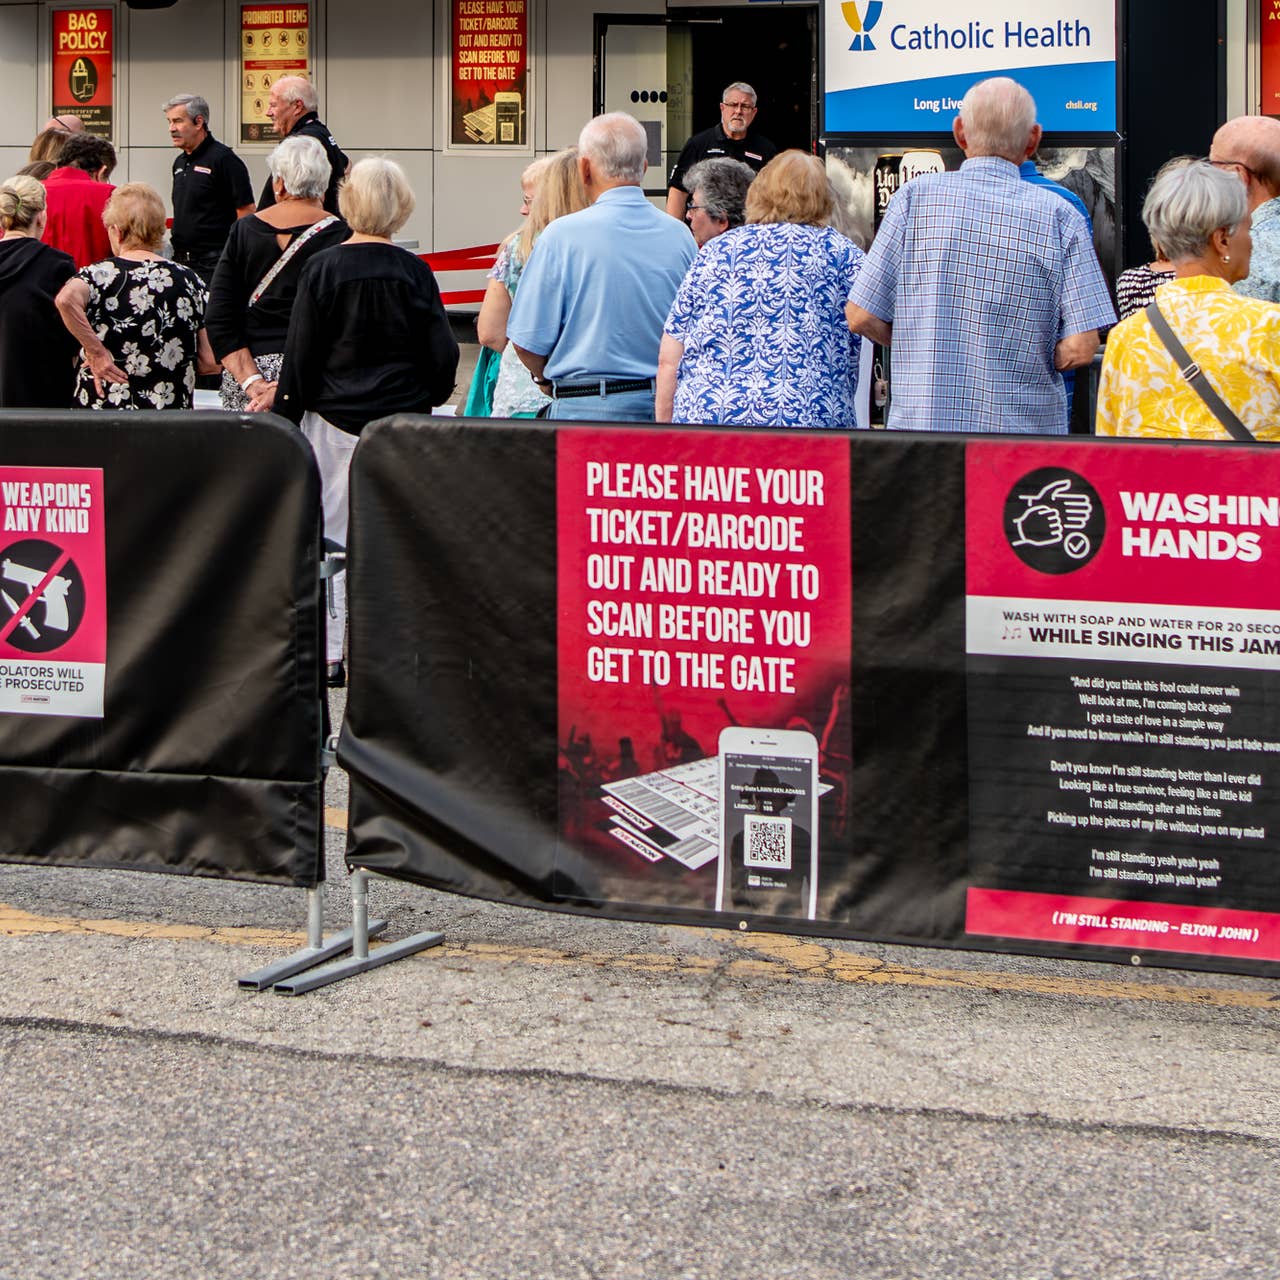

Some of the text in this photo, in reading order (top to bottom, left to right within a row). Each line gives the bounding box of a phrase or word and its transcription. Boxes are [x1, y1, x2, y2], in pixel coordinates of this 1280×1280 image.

[459, 0, 524, 14] PLEASE HAVE YOUR
[1269, 12, 1276, 20] A
[68, 13, 97, 30] BAG
[242, 9, 307, 24] PROHIBITED ITEMS
[459, 17, 518, 31] TICKET/BARCODE
[59, 32, 107, 49] POLICY
[459, 33, 522, 47] OUT AND READY TO
[890, 20, 1091, 50] Catholic Health
[459, 50, 520, 63] SCAN BEFORE YOU
[459, 66, 516, 80] GET TO THE GATE
[913, 98, 940, 112] Long
[1065, 100, 1098, 112] chsli.org
[587, 462, 824, 506] PLEASE HAVE YOUR
[2, 482, 91, 508] WEAPONS
[4, 508, 41, 532] ANY
[46, 508, 89, 534] KIND
[586, 508, 804, 552] TICKET/BARCODE
[1122, 528, 1261, 562] HANDS
[587, 554, 820, 600] OUT AND READY TO
[587, 600, 811, 648] SCAN BEFORE YOU
[1003, 611, 1039, 623] WASH
[1044, 613, 1076, 625] WITH
[1080, 615, 1114, 627] SOAP
[1118, 616, 1145, 627] AND
[1149, 618, 1193, 630] WATER
[1197, 620, 1223, 632] FOR
[1227, 621, 1243, 633] 20
[1029, 627, 1092, 646] WHILE
[1097, 630, 1182, 650] SINGING
[1187, 635, 1234, 653] THIS
[57, 667, 84, 680] WILL
[587, 646, 796, 694] GET TO THE GATE
[5, 678, 85, 692] PROSECUTED
[1092, 677, 1104, 689] did
[1104, 681, 1120, 691] you
[1122, 679, 1142, 692] think
[1143, 681, 1159, 693] this
[1160, 681, 1175, 693] fool
[1177, 683, 1199, 695] could
[1201, 686, 1223, 696] never
[1224, 686, 1240, 697] win
[1079, 914, 1108, 928] STILL
[1110, 917, 1170, 933] STANDING
[1180, 922, 1216, 937] ELTON
